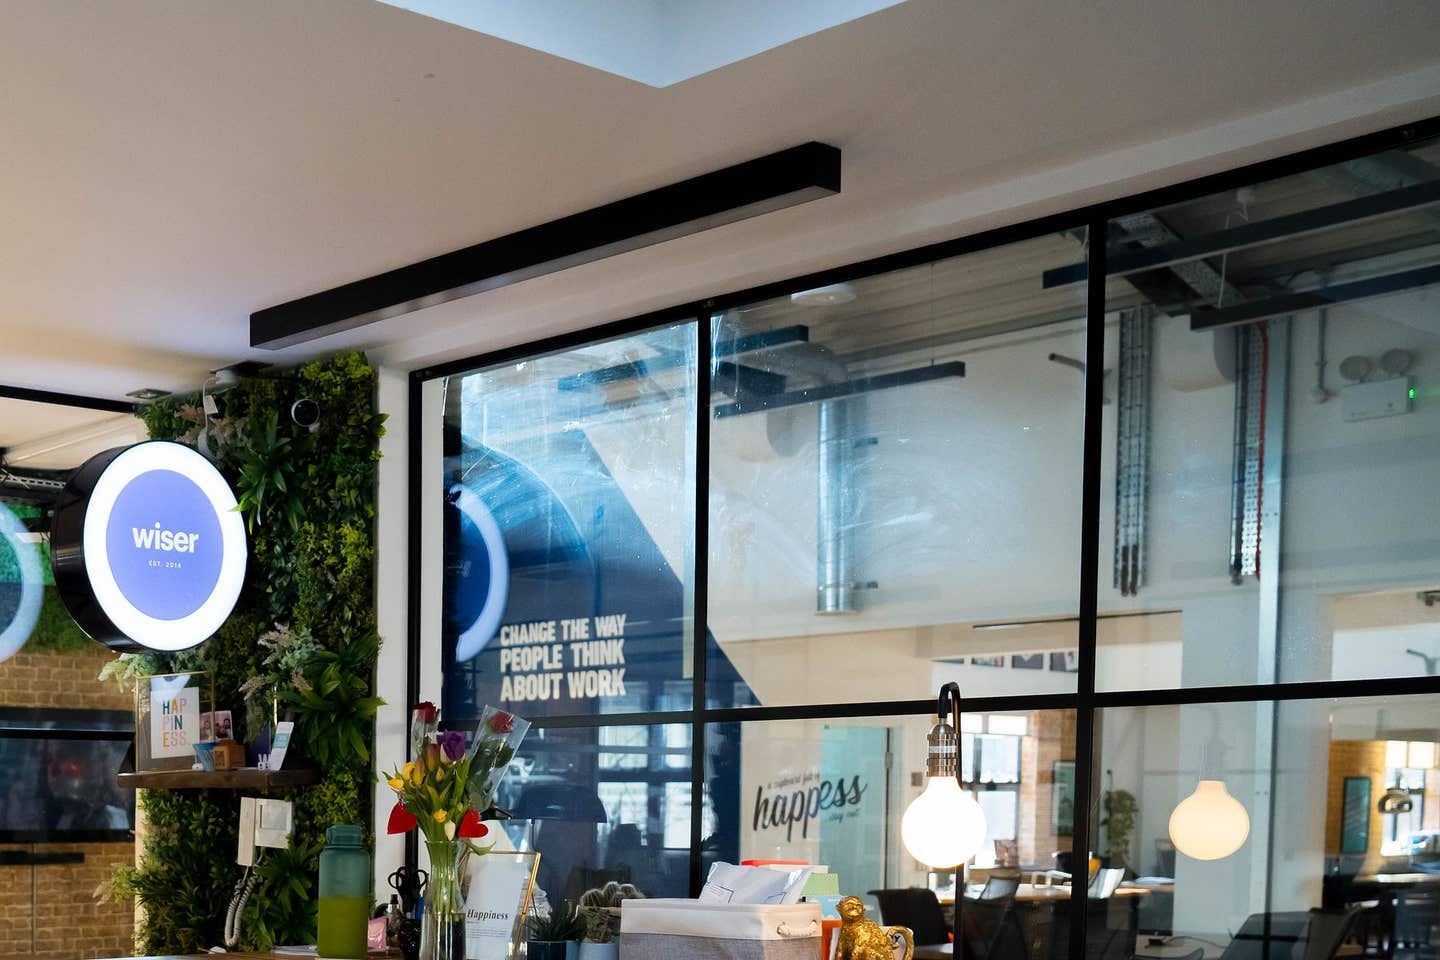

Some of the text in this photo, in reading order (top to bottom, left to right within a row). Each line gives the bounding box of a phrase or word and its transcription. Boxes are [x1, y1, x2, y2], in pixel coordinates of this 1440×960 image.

[132, 521, 199, 553] wiser
[500, 613, 627, 646] CHANGE THE WAY
[500, 638, 626, 673] PEOPLE THINK
[500, 668, 627, 702] ABOUT WORK
[162, 698, 187, 715] HAP
[162, 714, 183, 731] PIN
[466, 908, 509, 920] Happiness
